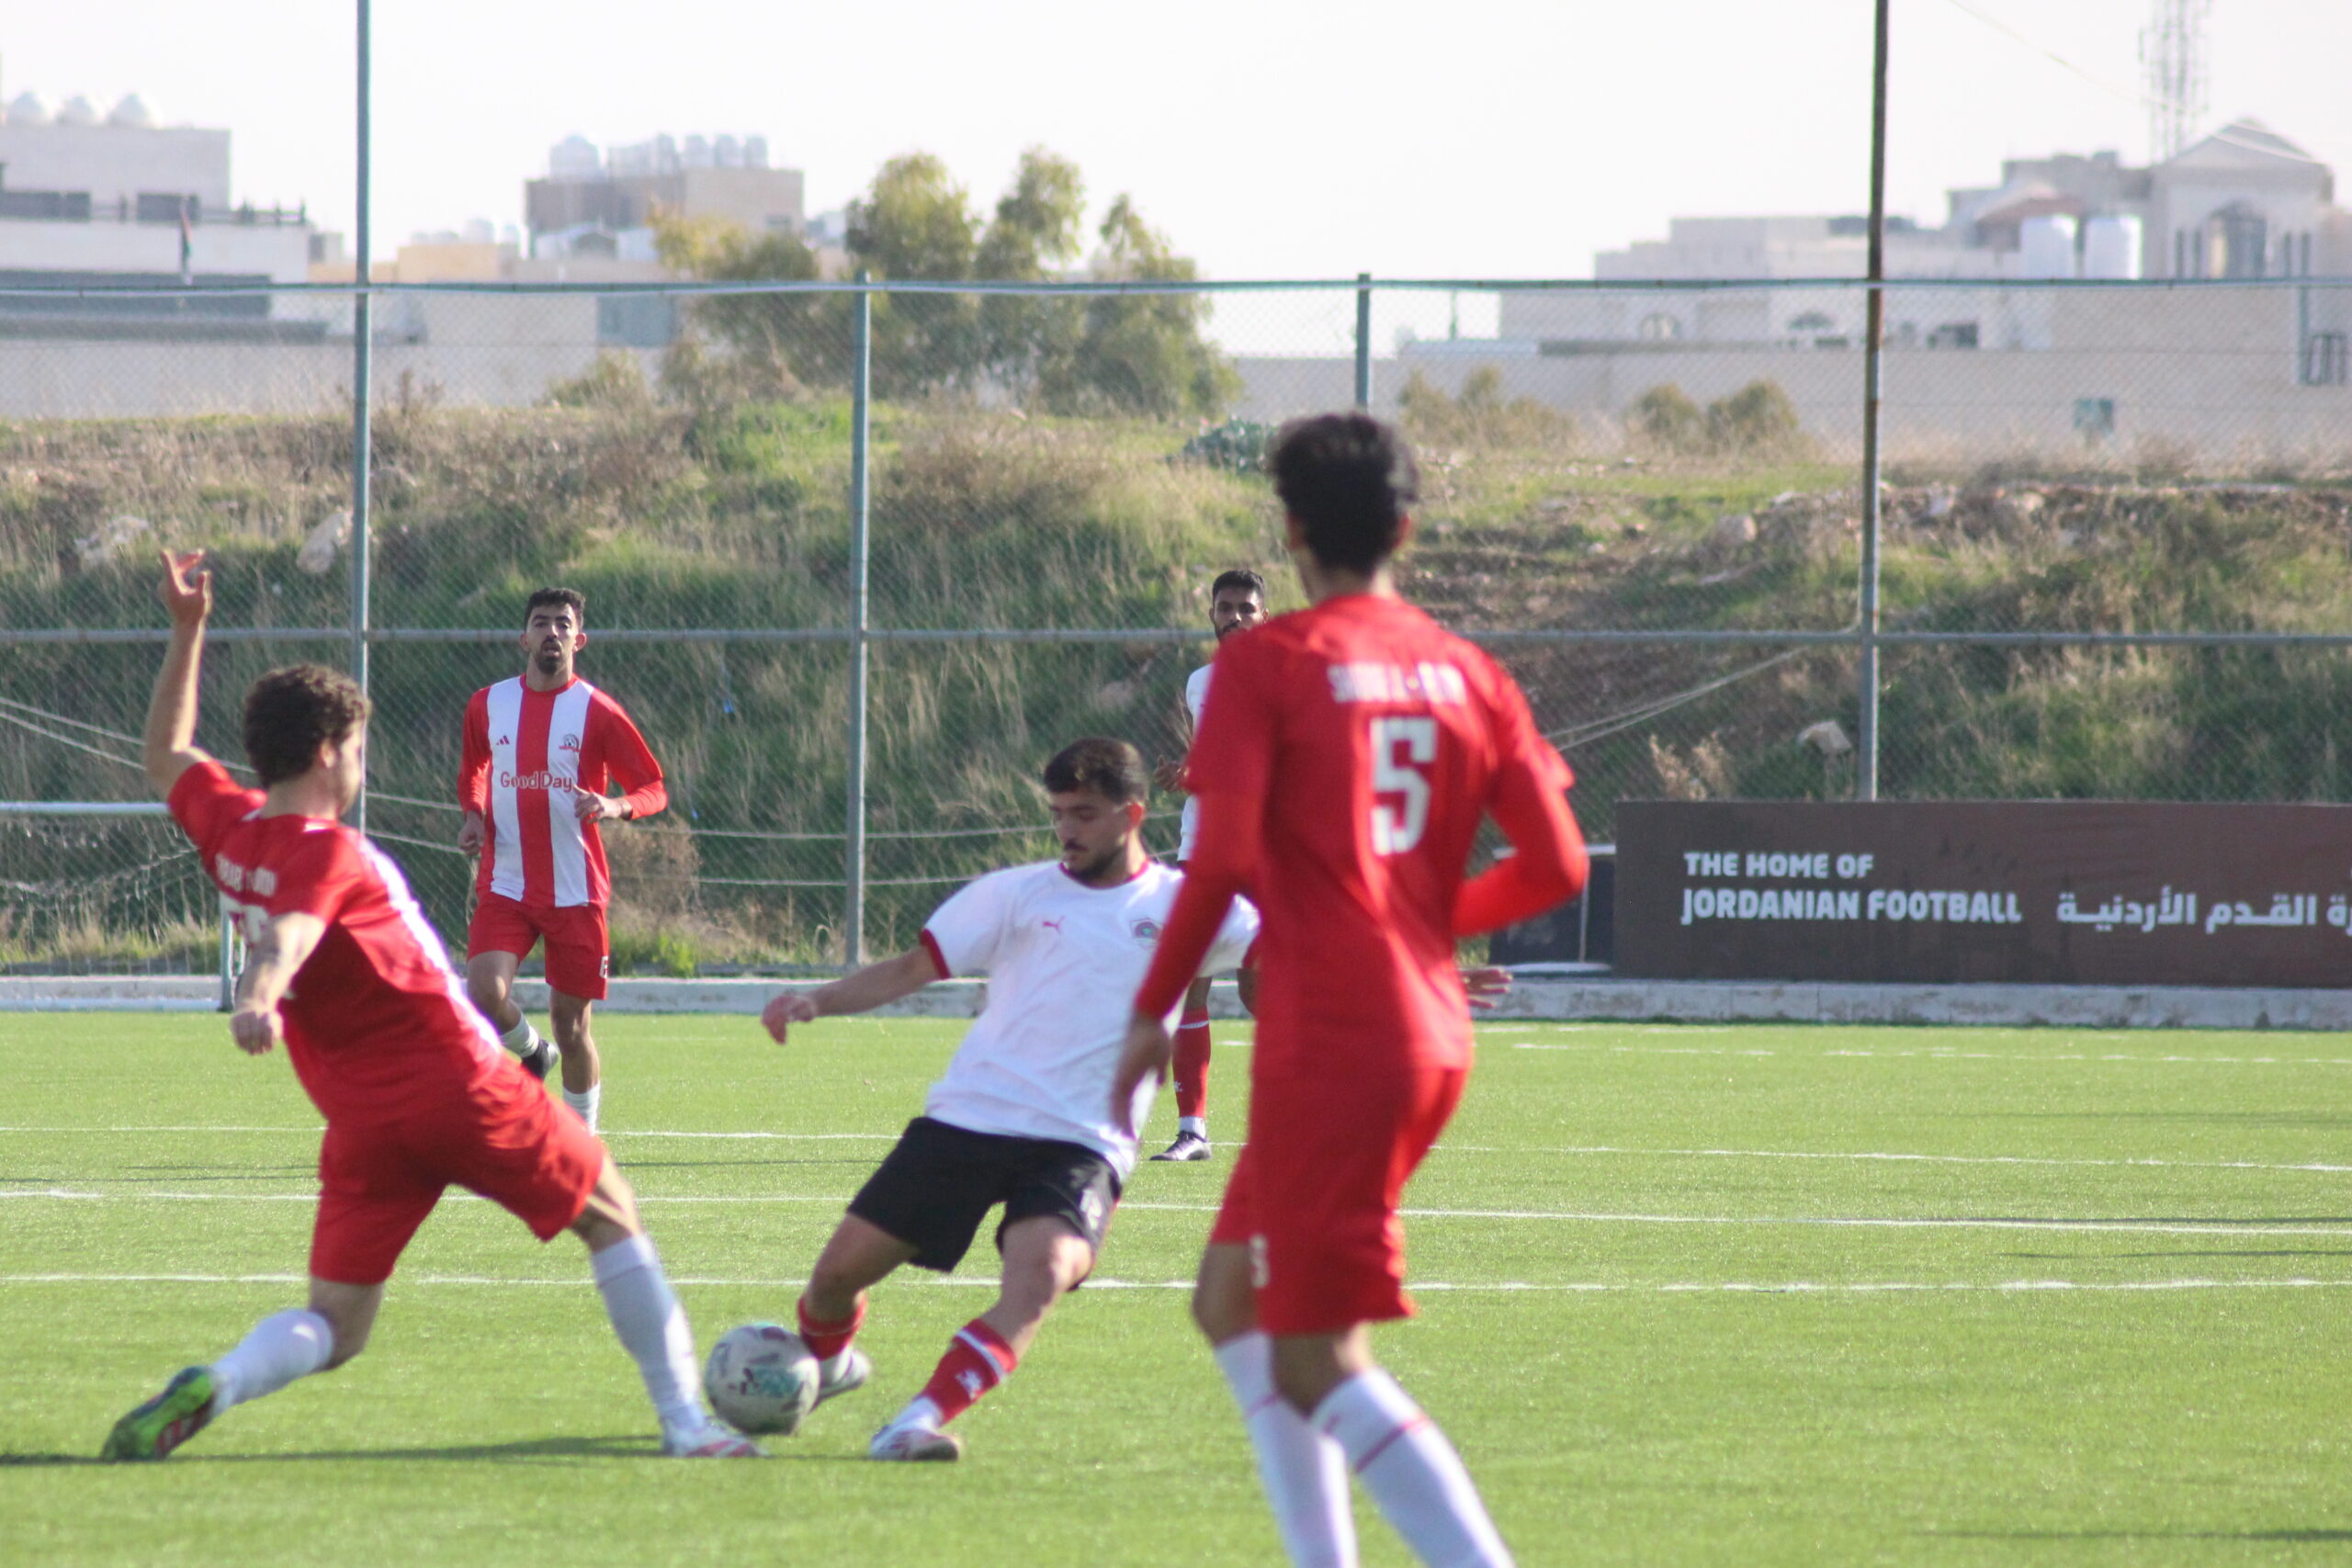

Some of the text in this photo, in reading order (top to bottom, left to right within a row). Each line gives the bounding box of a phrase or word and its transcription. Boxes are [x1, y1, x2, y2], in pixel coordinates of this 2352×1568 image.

[1369, 716, 1437, 855] 5
[1683, 852, 1873, 878] THE HOME OF
[1680, 888, 2023, 925] JORDANIAN FOOTBALL
[2056, 885, 2196, 932] الأردنية
[2206, 893, 2317, 934] القدم
